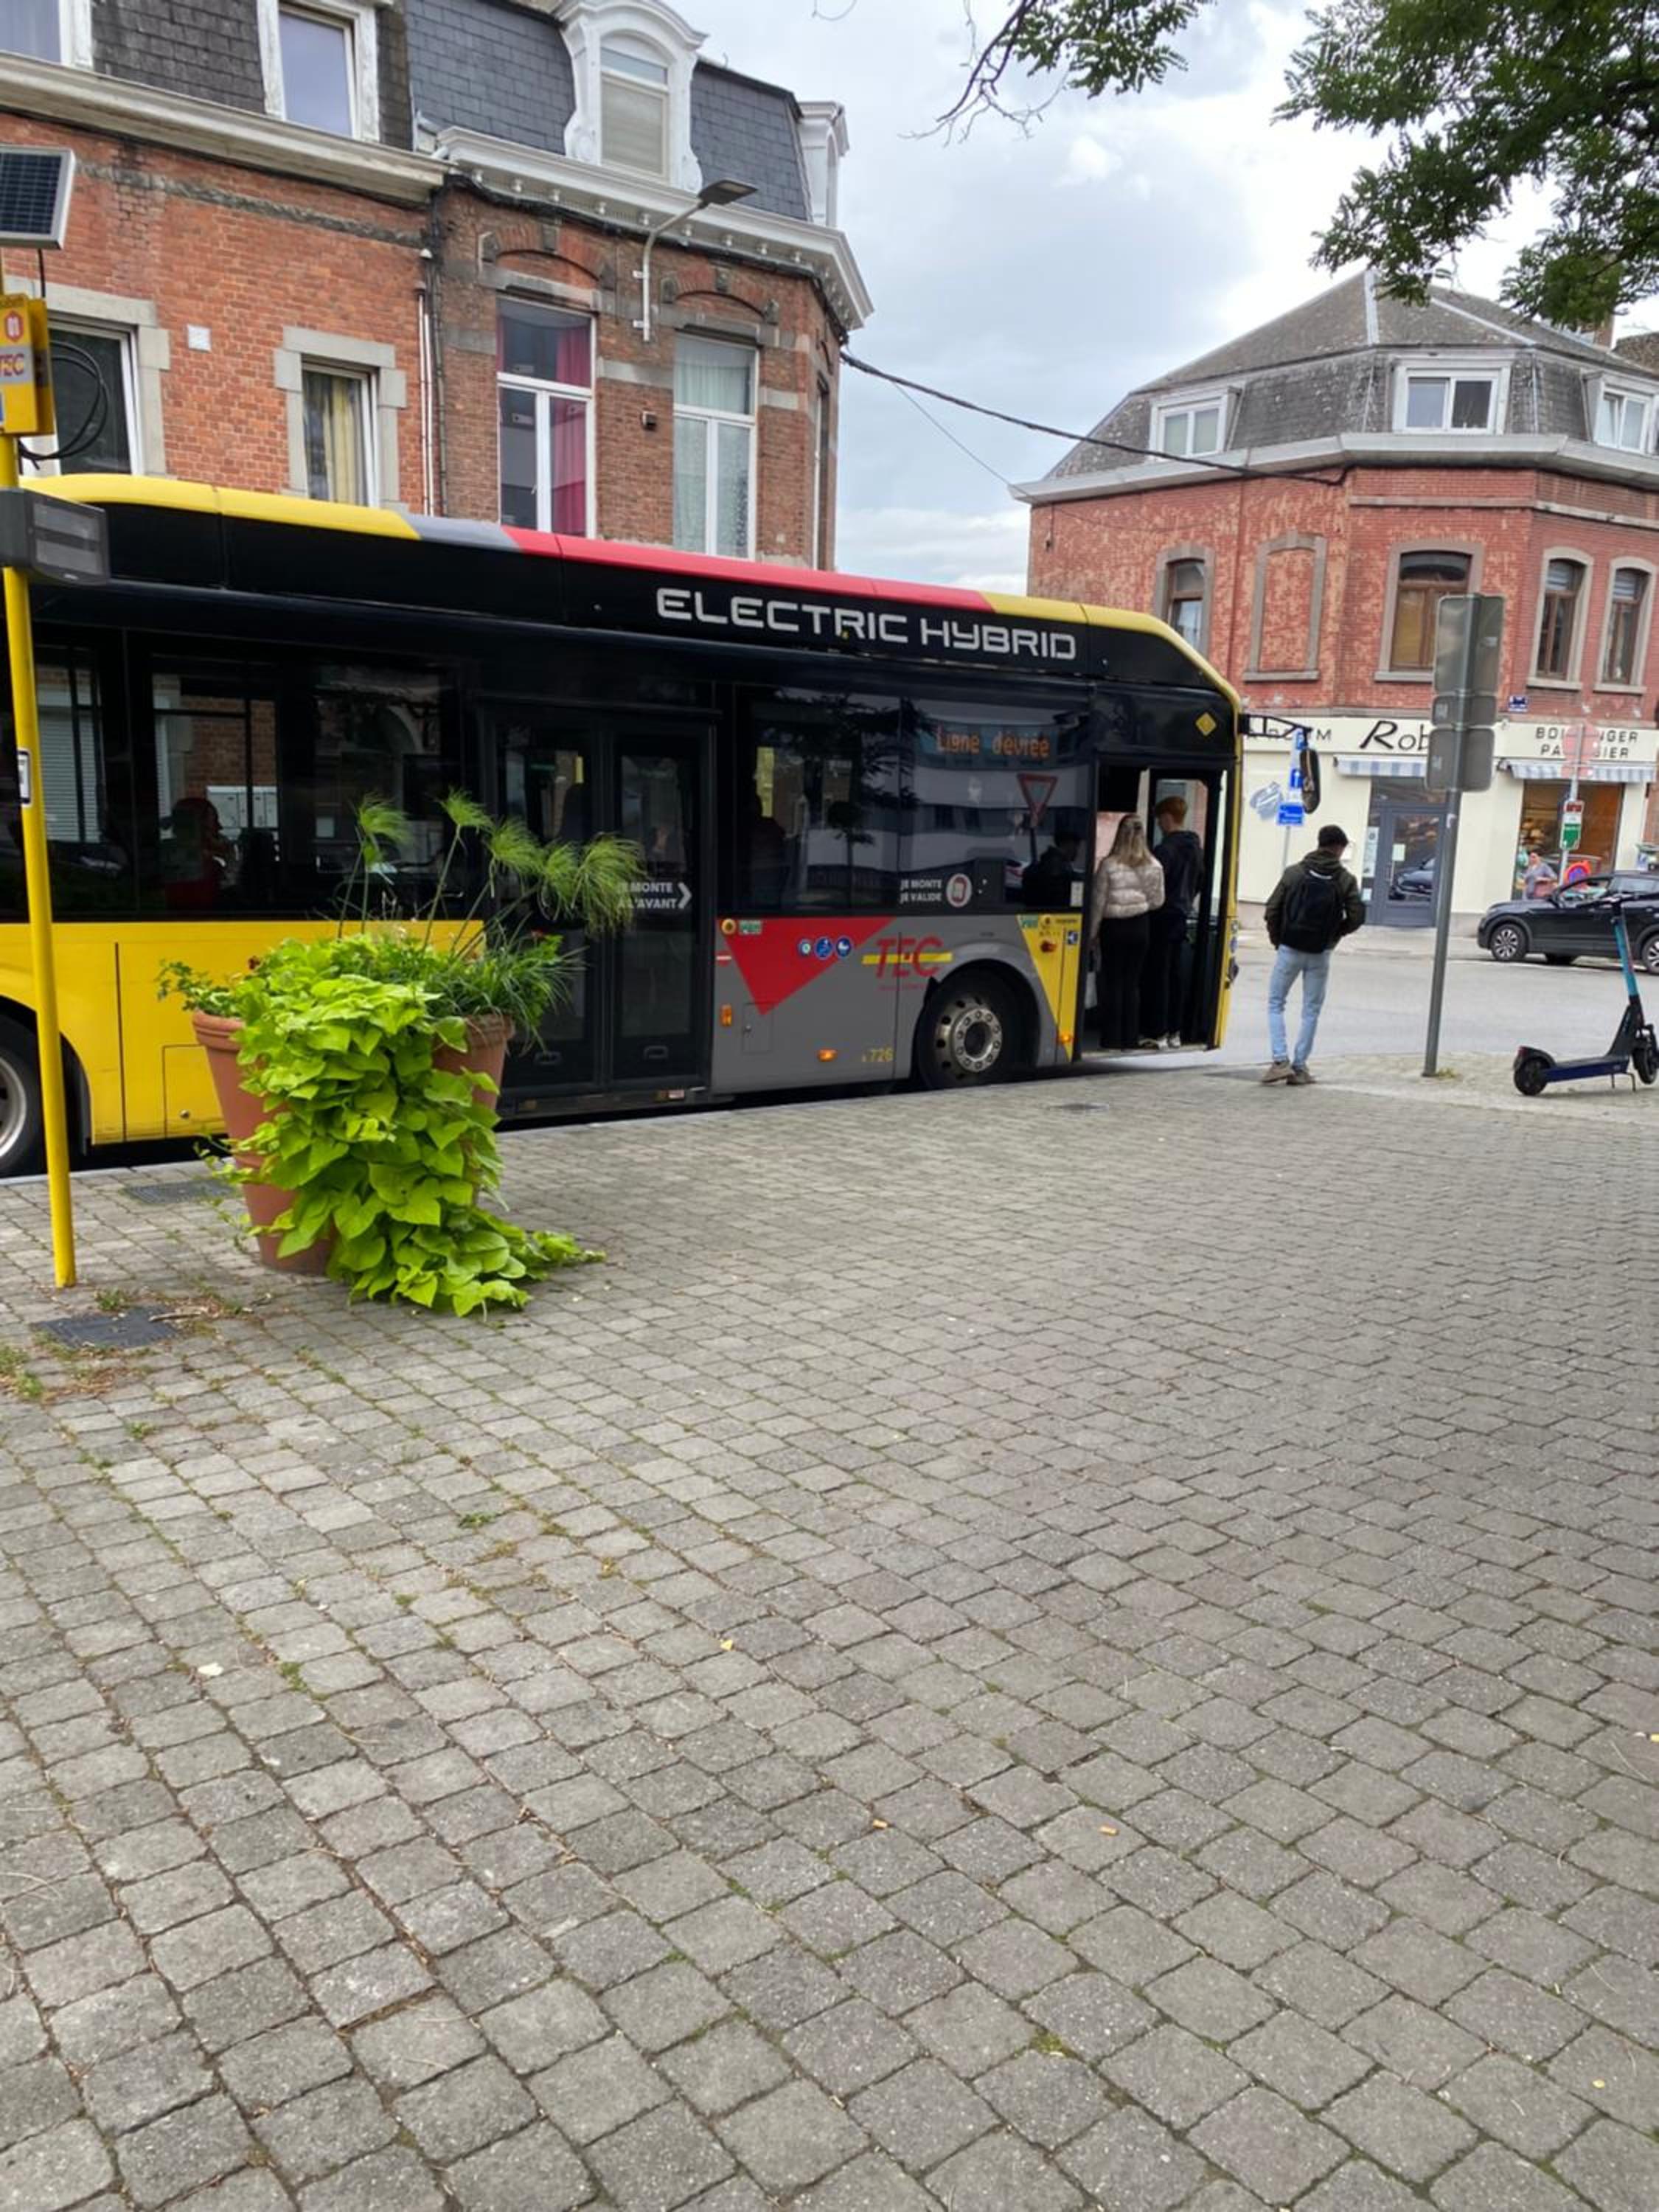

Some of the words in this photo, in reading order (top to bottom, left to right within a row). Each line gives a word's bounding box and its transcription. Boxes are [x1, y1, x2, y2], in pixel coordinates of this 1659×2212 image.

[656, 588, 908, 644] ELECTRIC
[920, 617, 1077, 660] HYBRID
[1359, 720, 1429, 750] Rob
[1535, 726, 1638, 743] BOGER
[1540, 744, 1630, 759] PAIER
[875, 936, 944, 978] TEC
